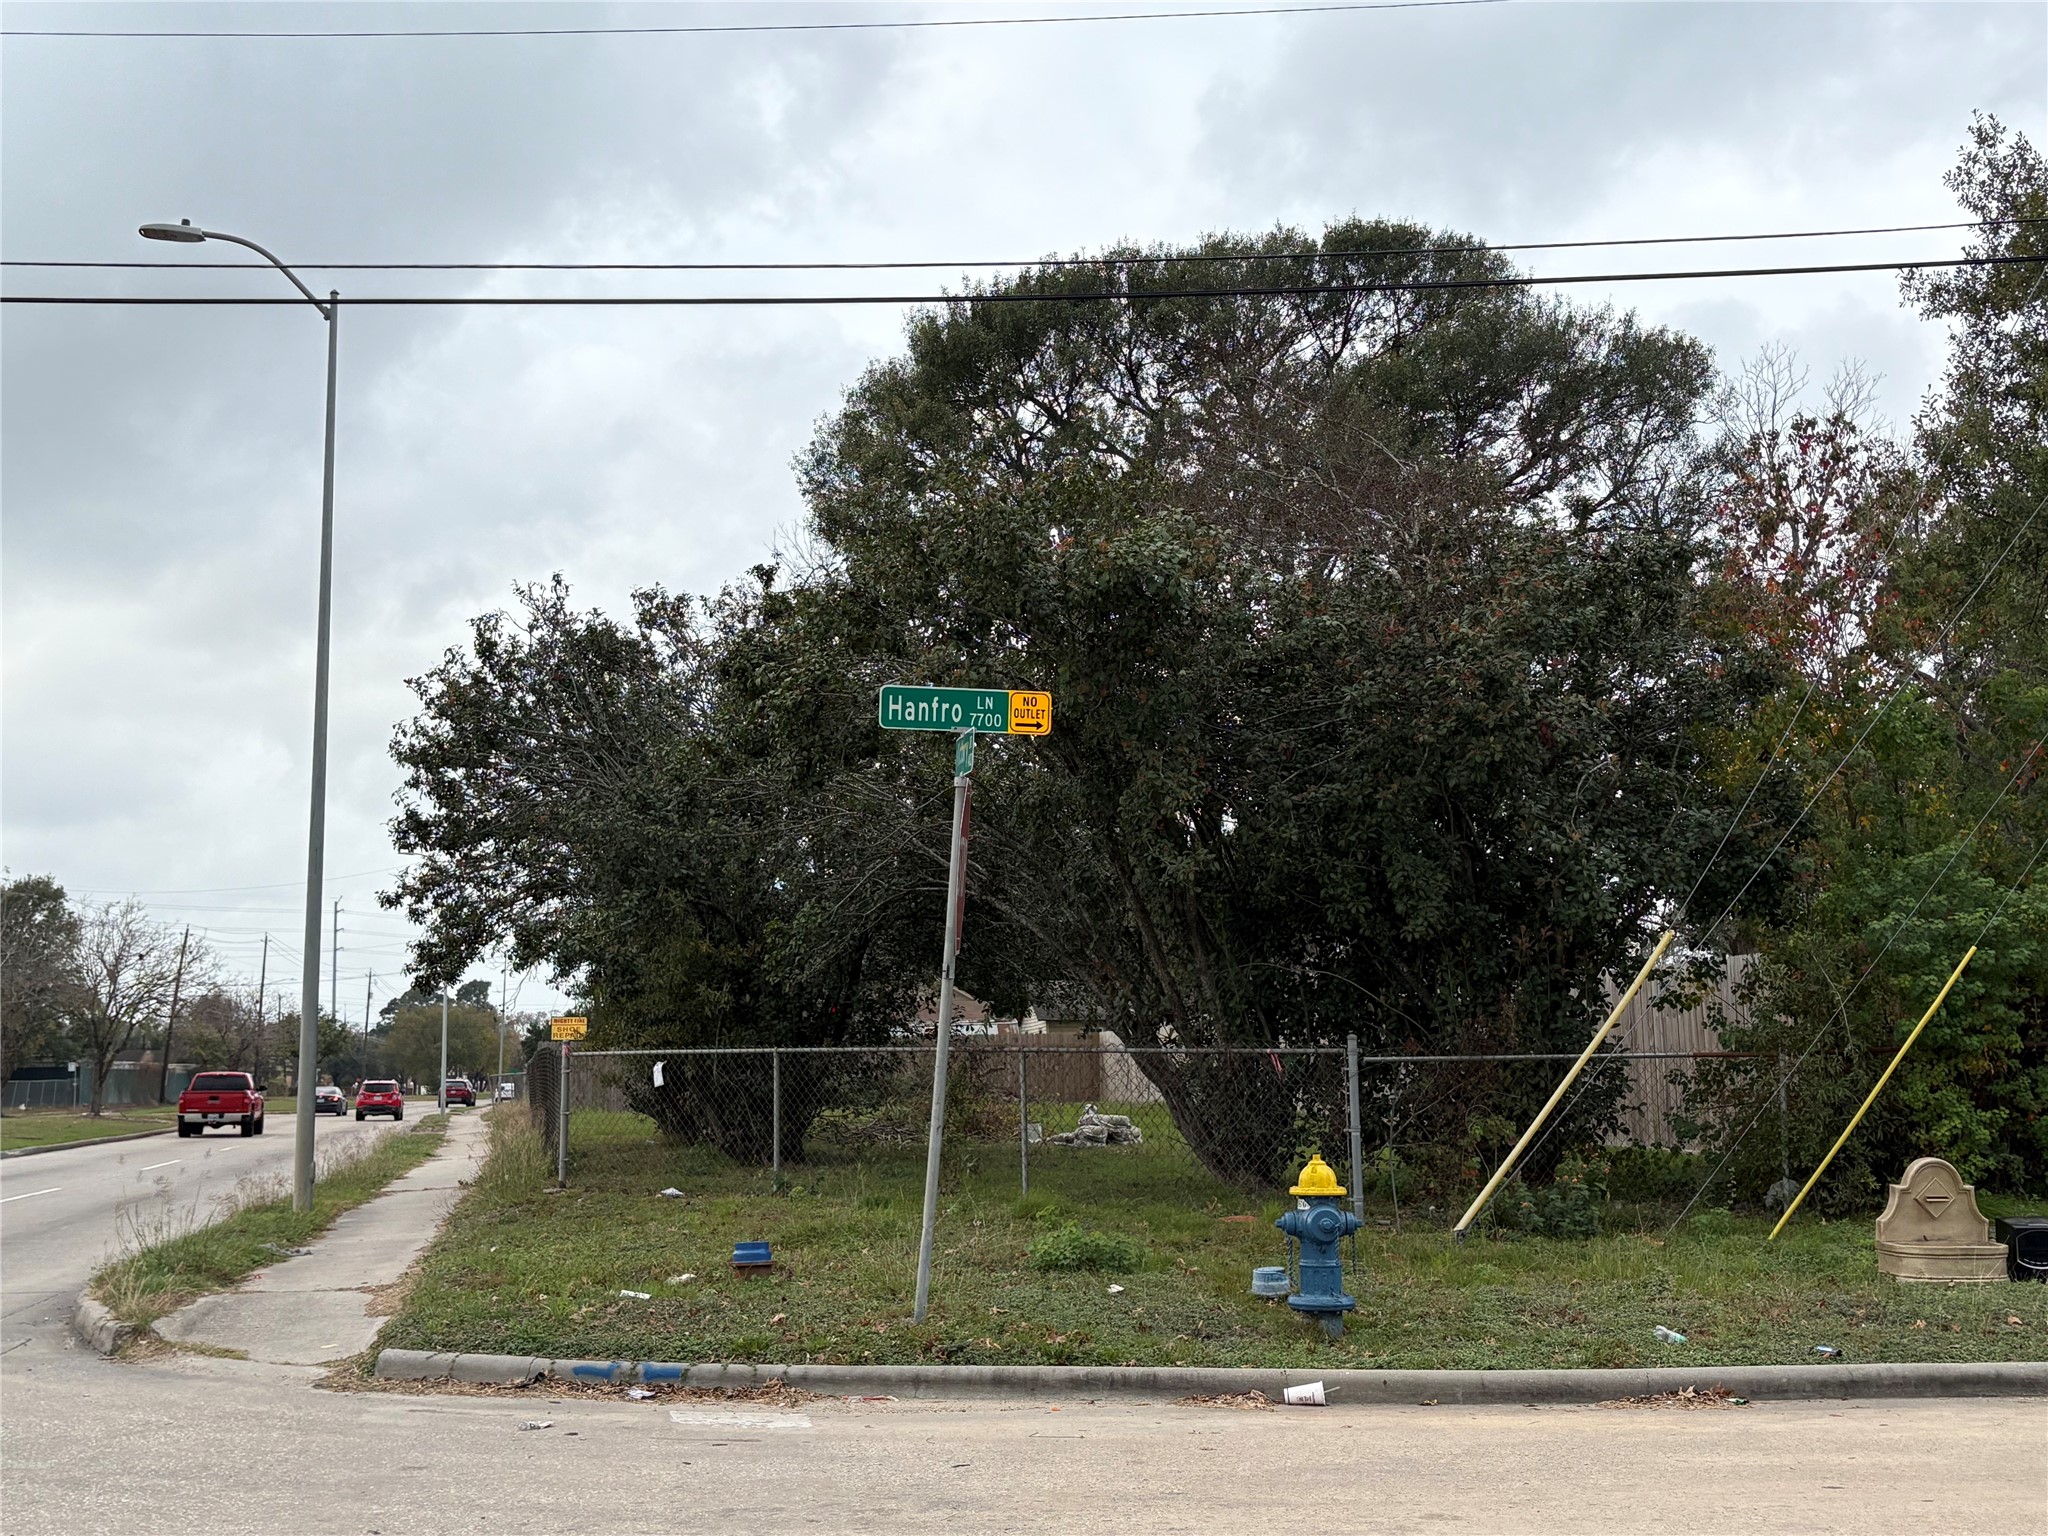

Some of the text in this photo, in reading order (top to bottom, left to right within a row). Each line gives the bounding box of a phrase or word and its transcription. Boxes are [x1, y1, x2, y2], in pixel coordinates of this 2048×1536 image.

[1022, 696, 1038, 707] NO
[888, 694, 994, 723] Hanfro LN
[1013, 708, 1046, 720] OUTLET
[969, 713, 1002, 728] 7700
